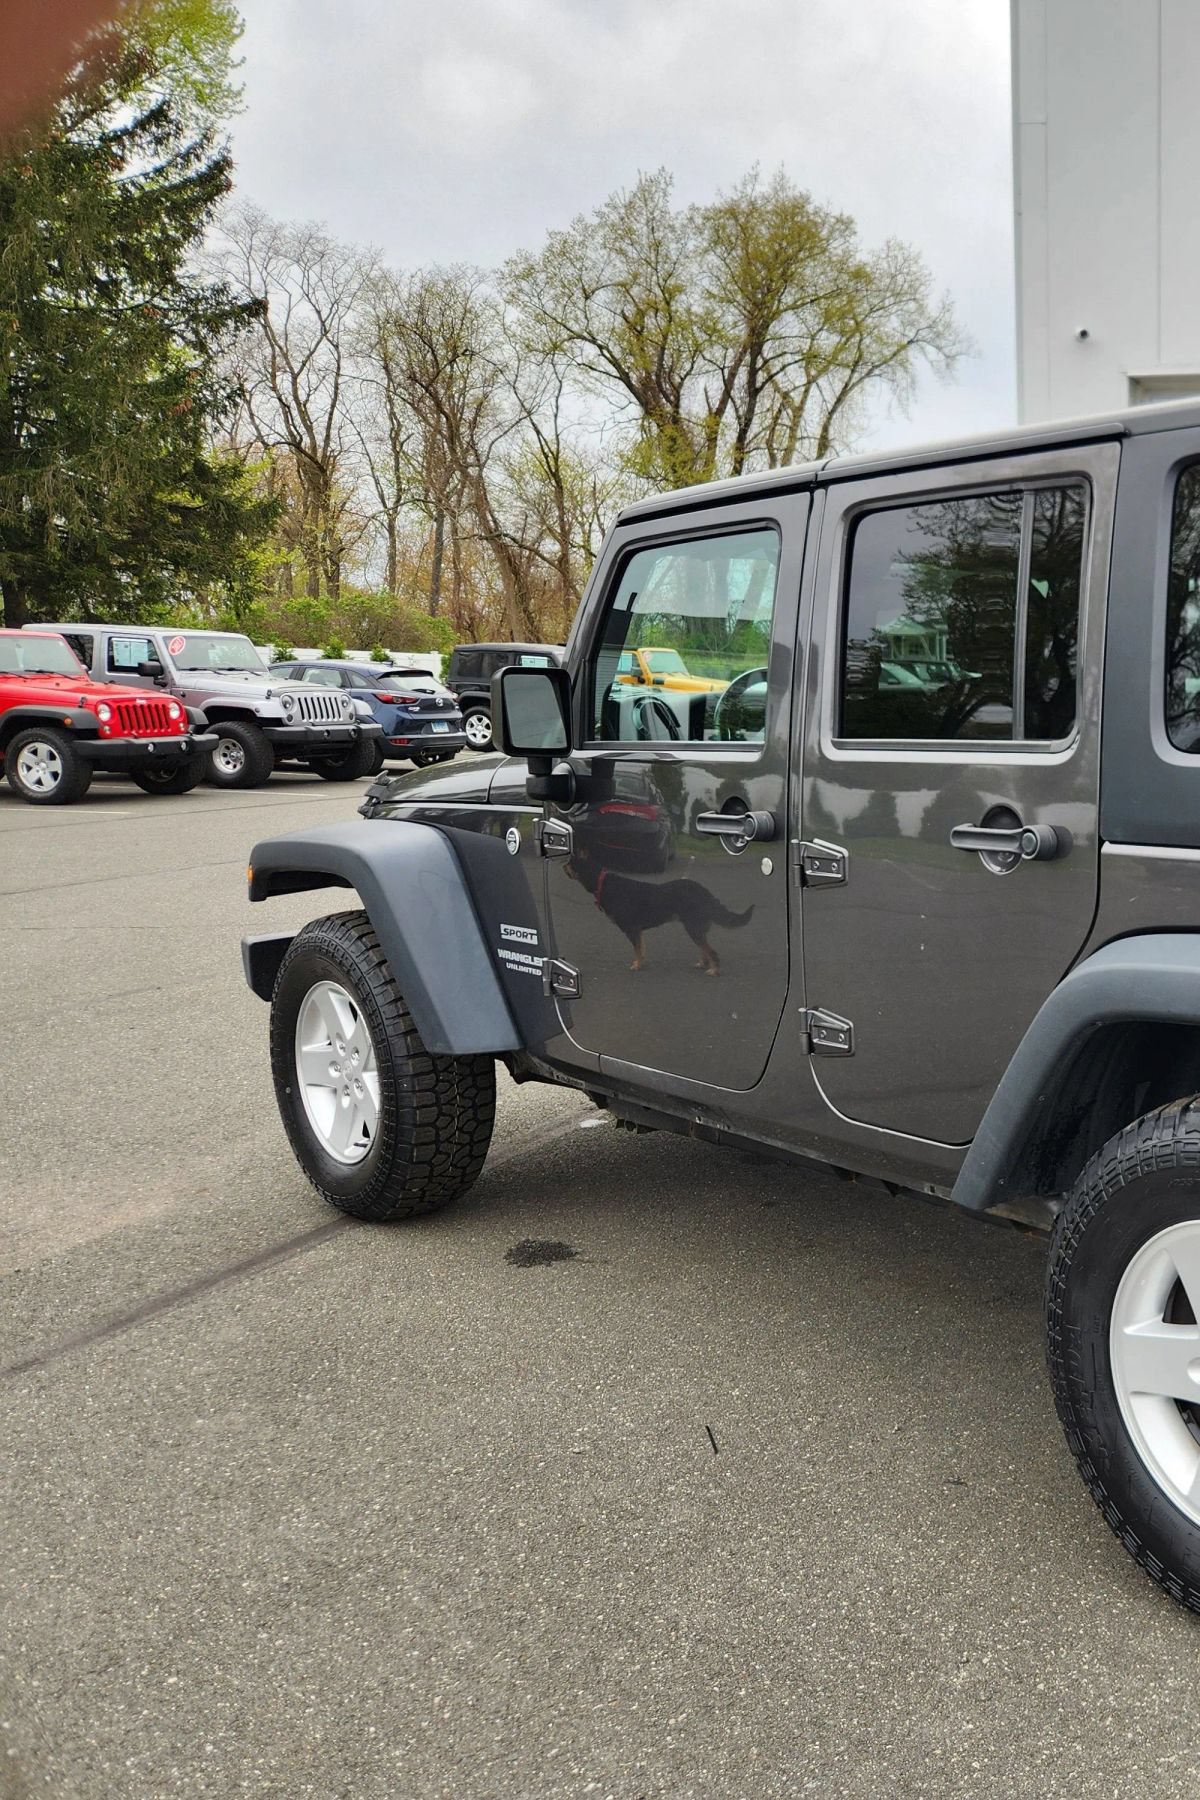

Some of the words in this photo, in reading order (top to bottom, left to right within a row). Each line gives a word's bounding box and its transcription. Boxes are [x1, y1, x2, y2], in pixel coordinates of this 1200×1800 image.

[502, 926, 537, 943] SPORT
[497, 949, 543, 967] WRANGLE
[506, 962, 542, 976] UNLIMITED
